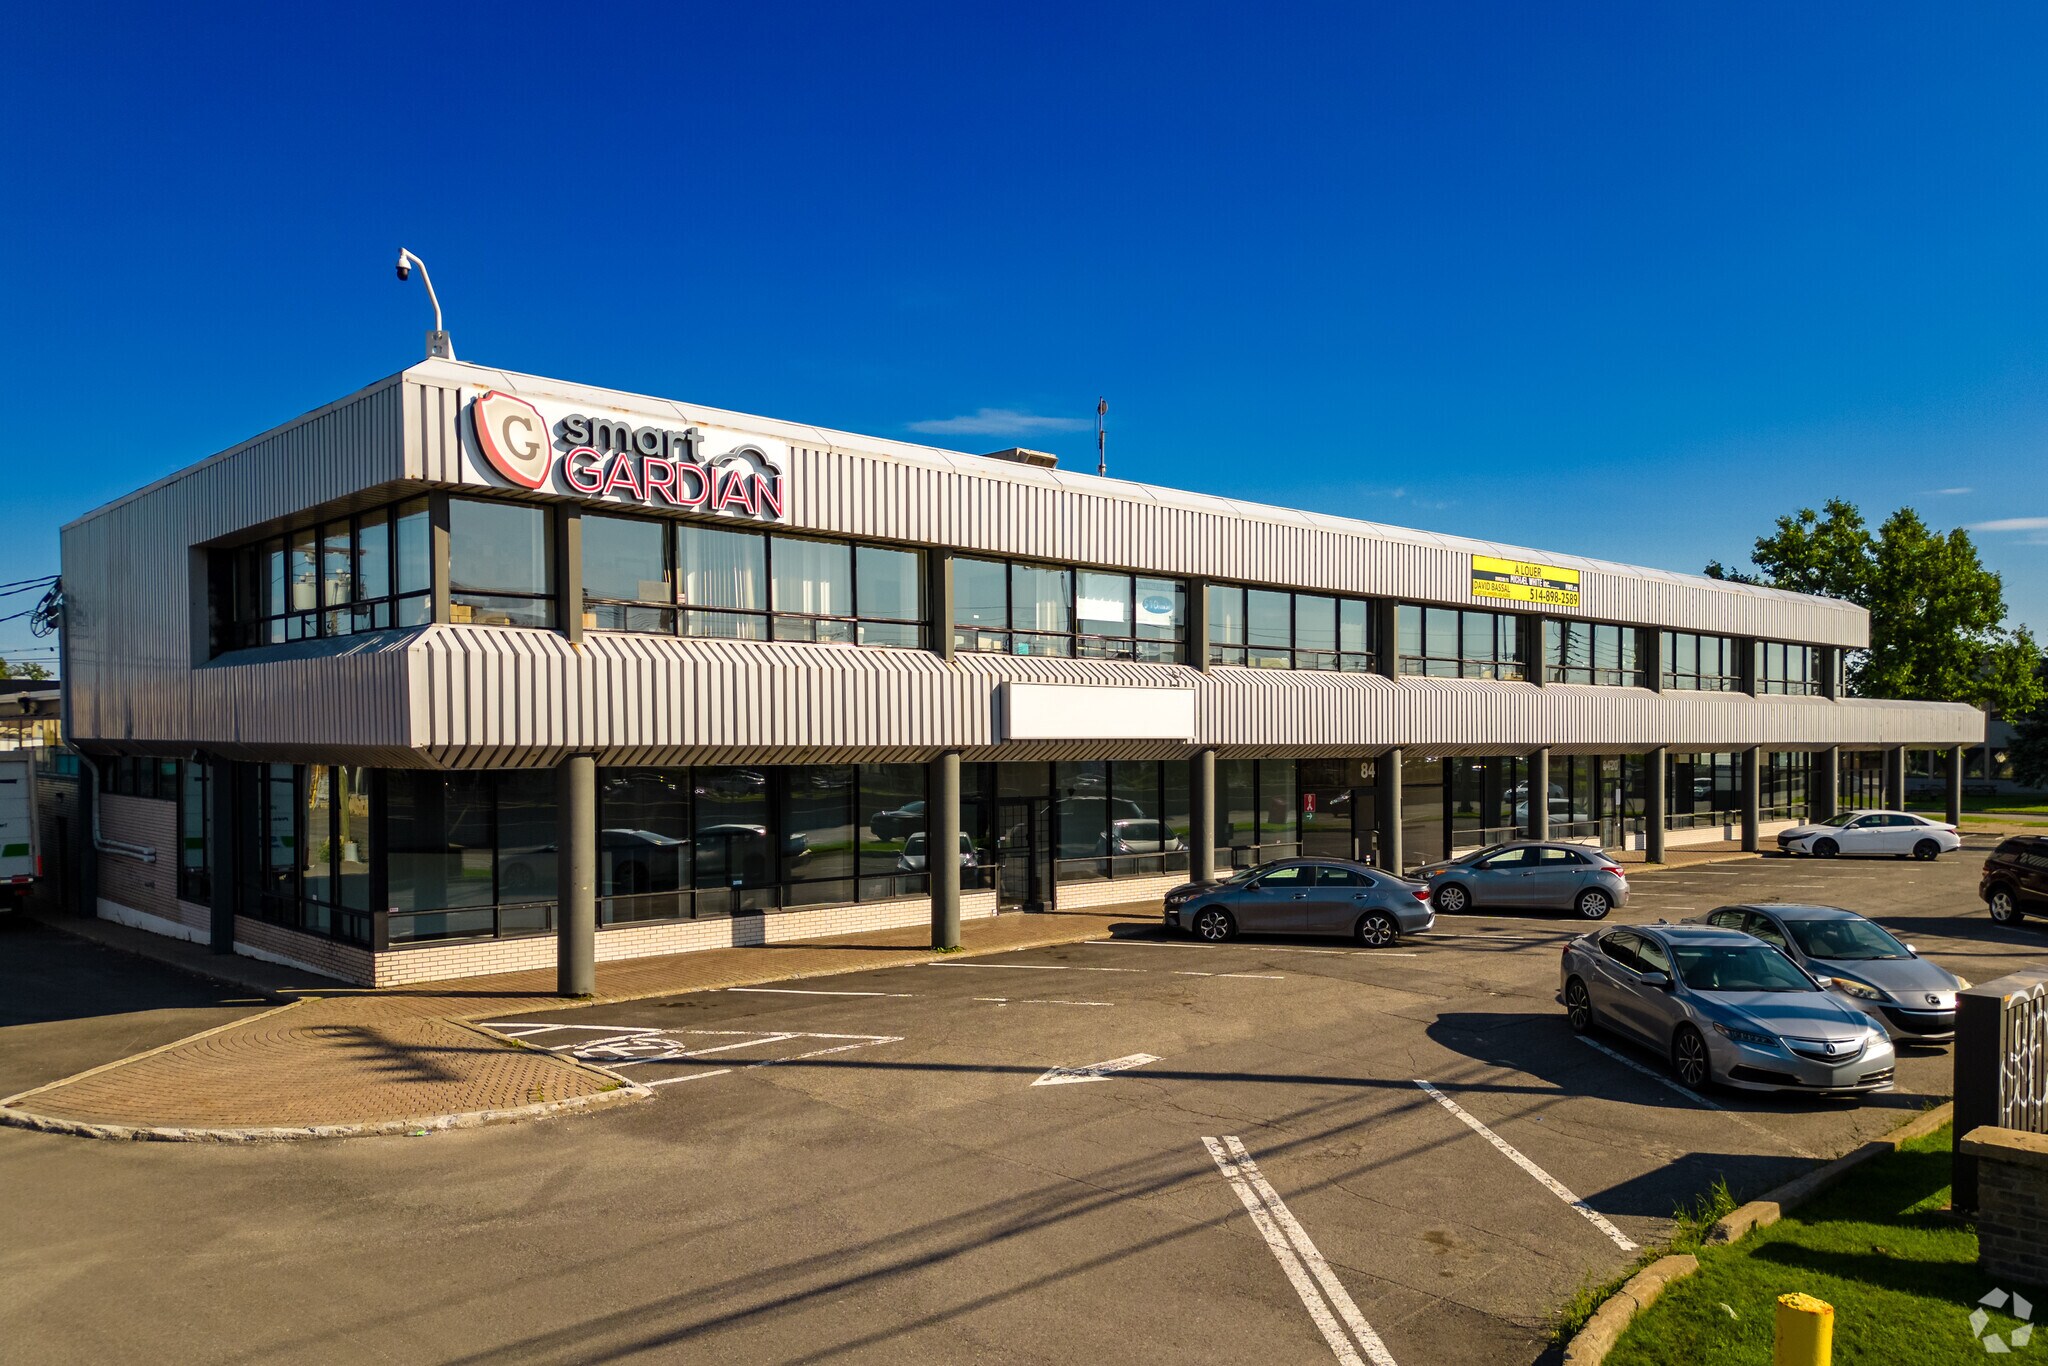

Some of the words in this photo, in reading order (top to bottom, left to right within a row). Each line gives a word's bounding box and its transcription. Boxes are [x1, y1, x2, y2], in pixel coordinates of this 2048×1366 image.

[502, 415, 541, 461] G
[562, 413, 704, 462] smart
[564, 446, 785, 518] GARDIAN
[1474, 580, 1491, 591] DAVID
[1521, 565, 1541, 577] LOUER
[1530, 588, 1578, 605] 514-898-2589
